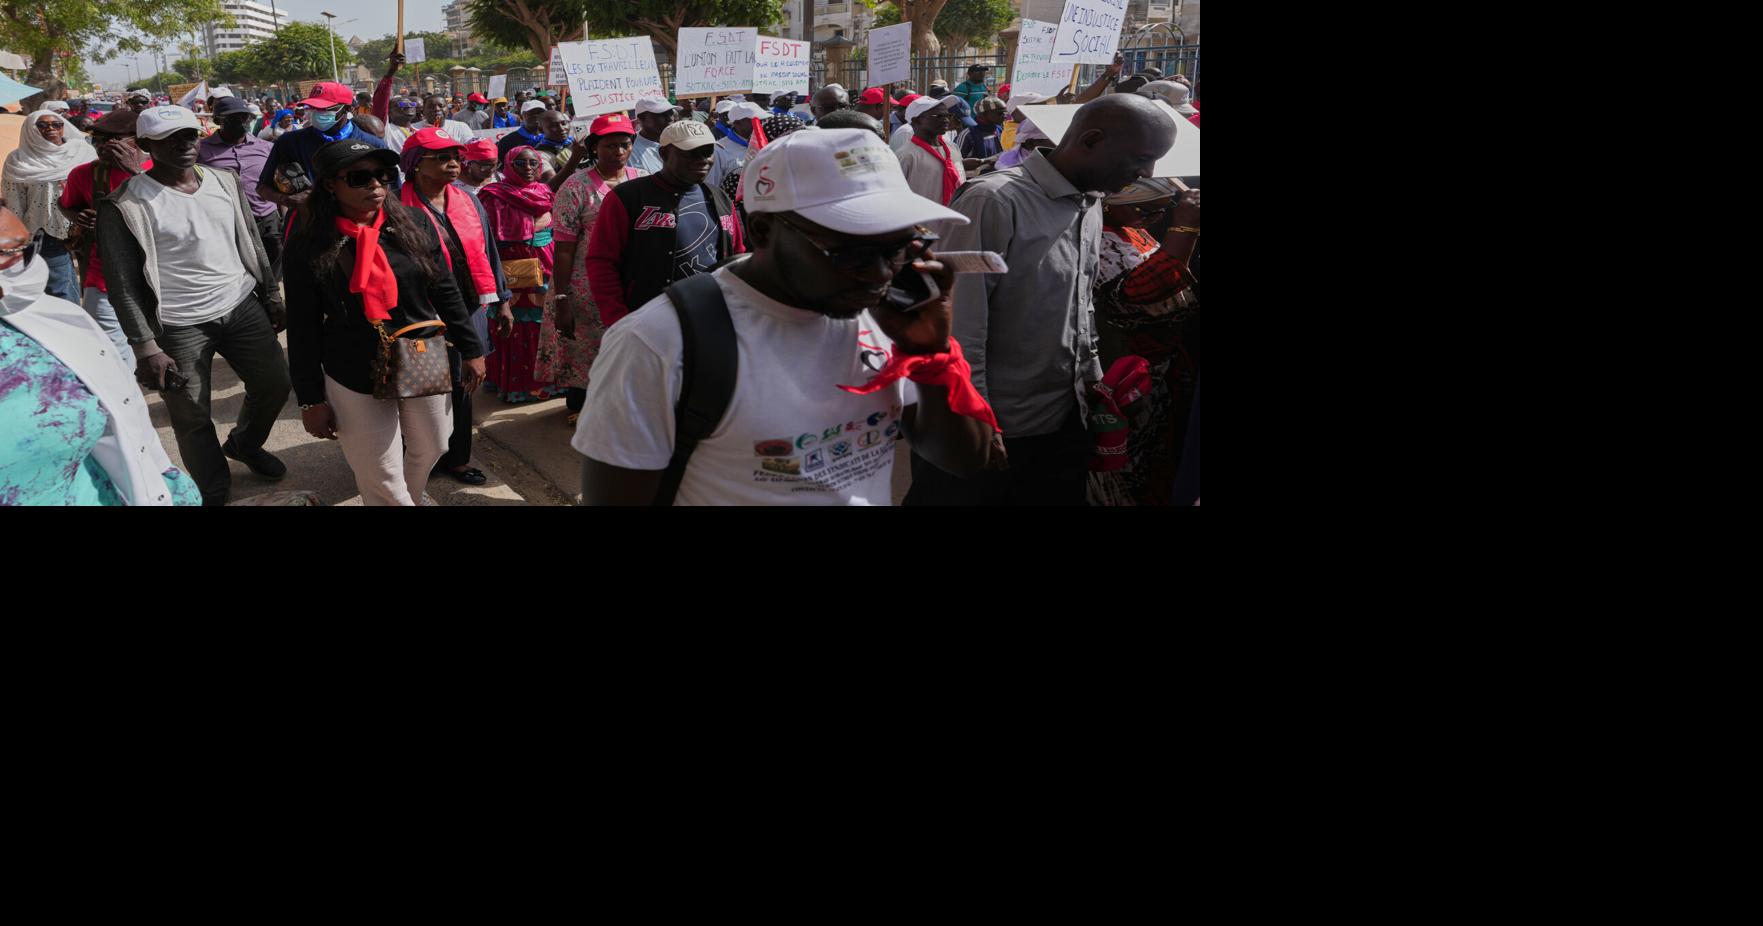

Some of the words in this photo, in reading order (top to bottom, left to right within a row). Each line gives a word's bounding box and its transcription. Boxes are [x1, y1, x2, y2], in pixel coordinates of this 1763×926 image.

[761, 40, 801, 58] FSDT
[704, 66, 736, 78] FORCE
[586, 93, 634, 108] JUSTICE
